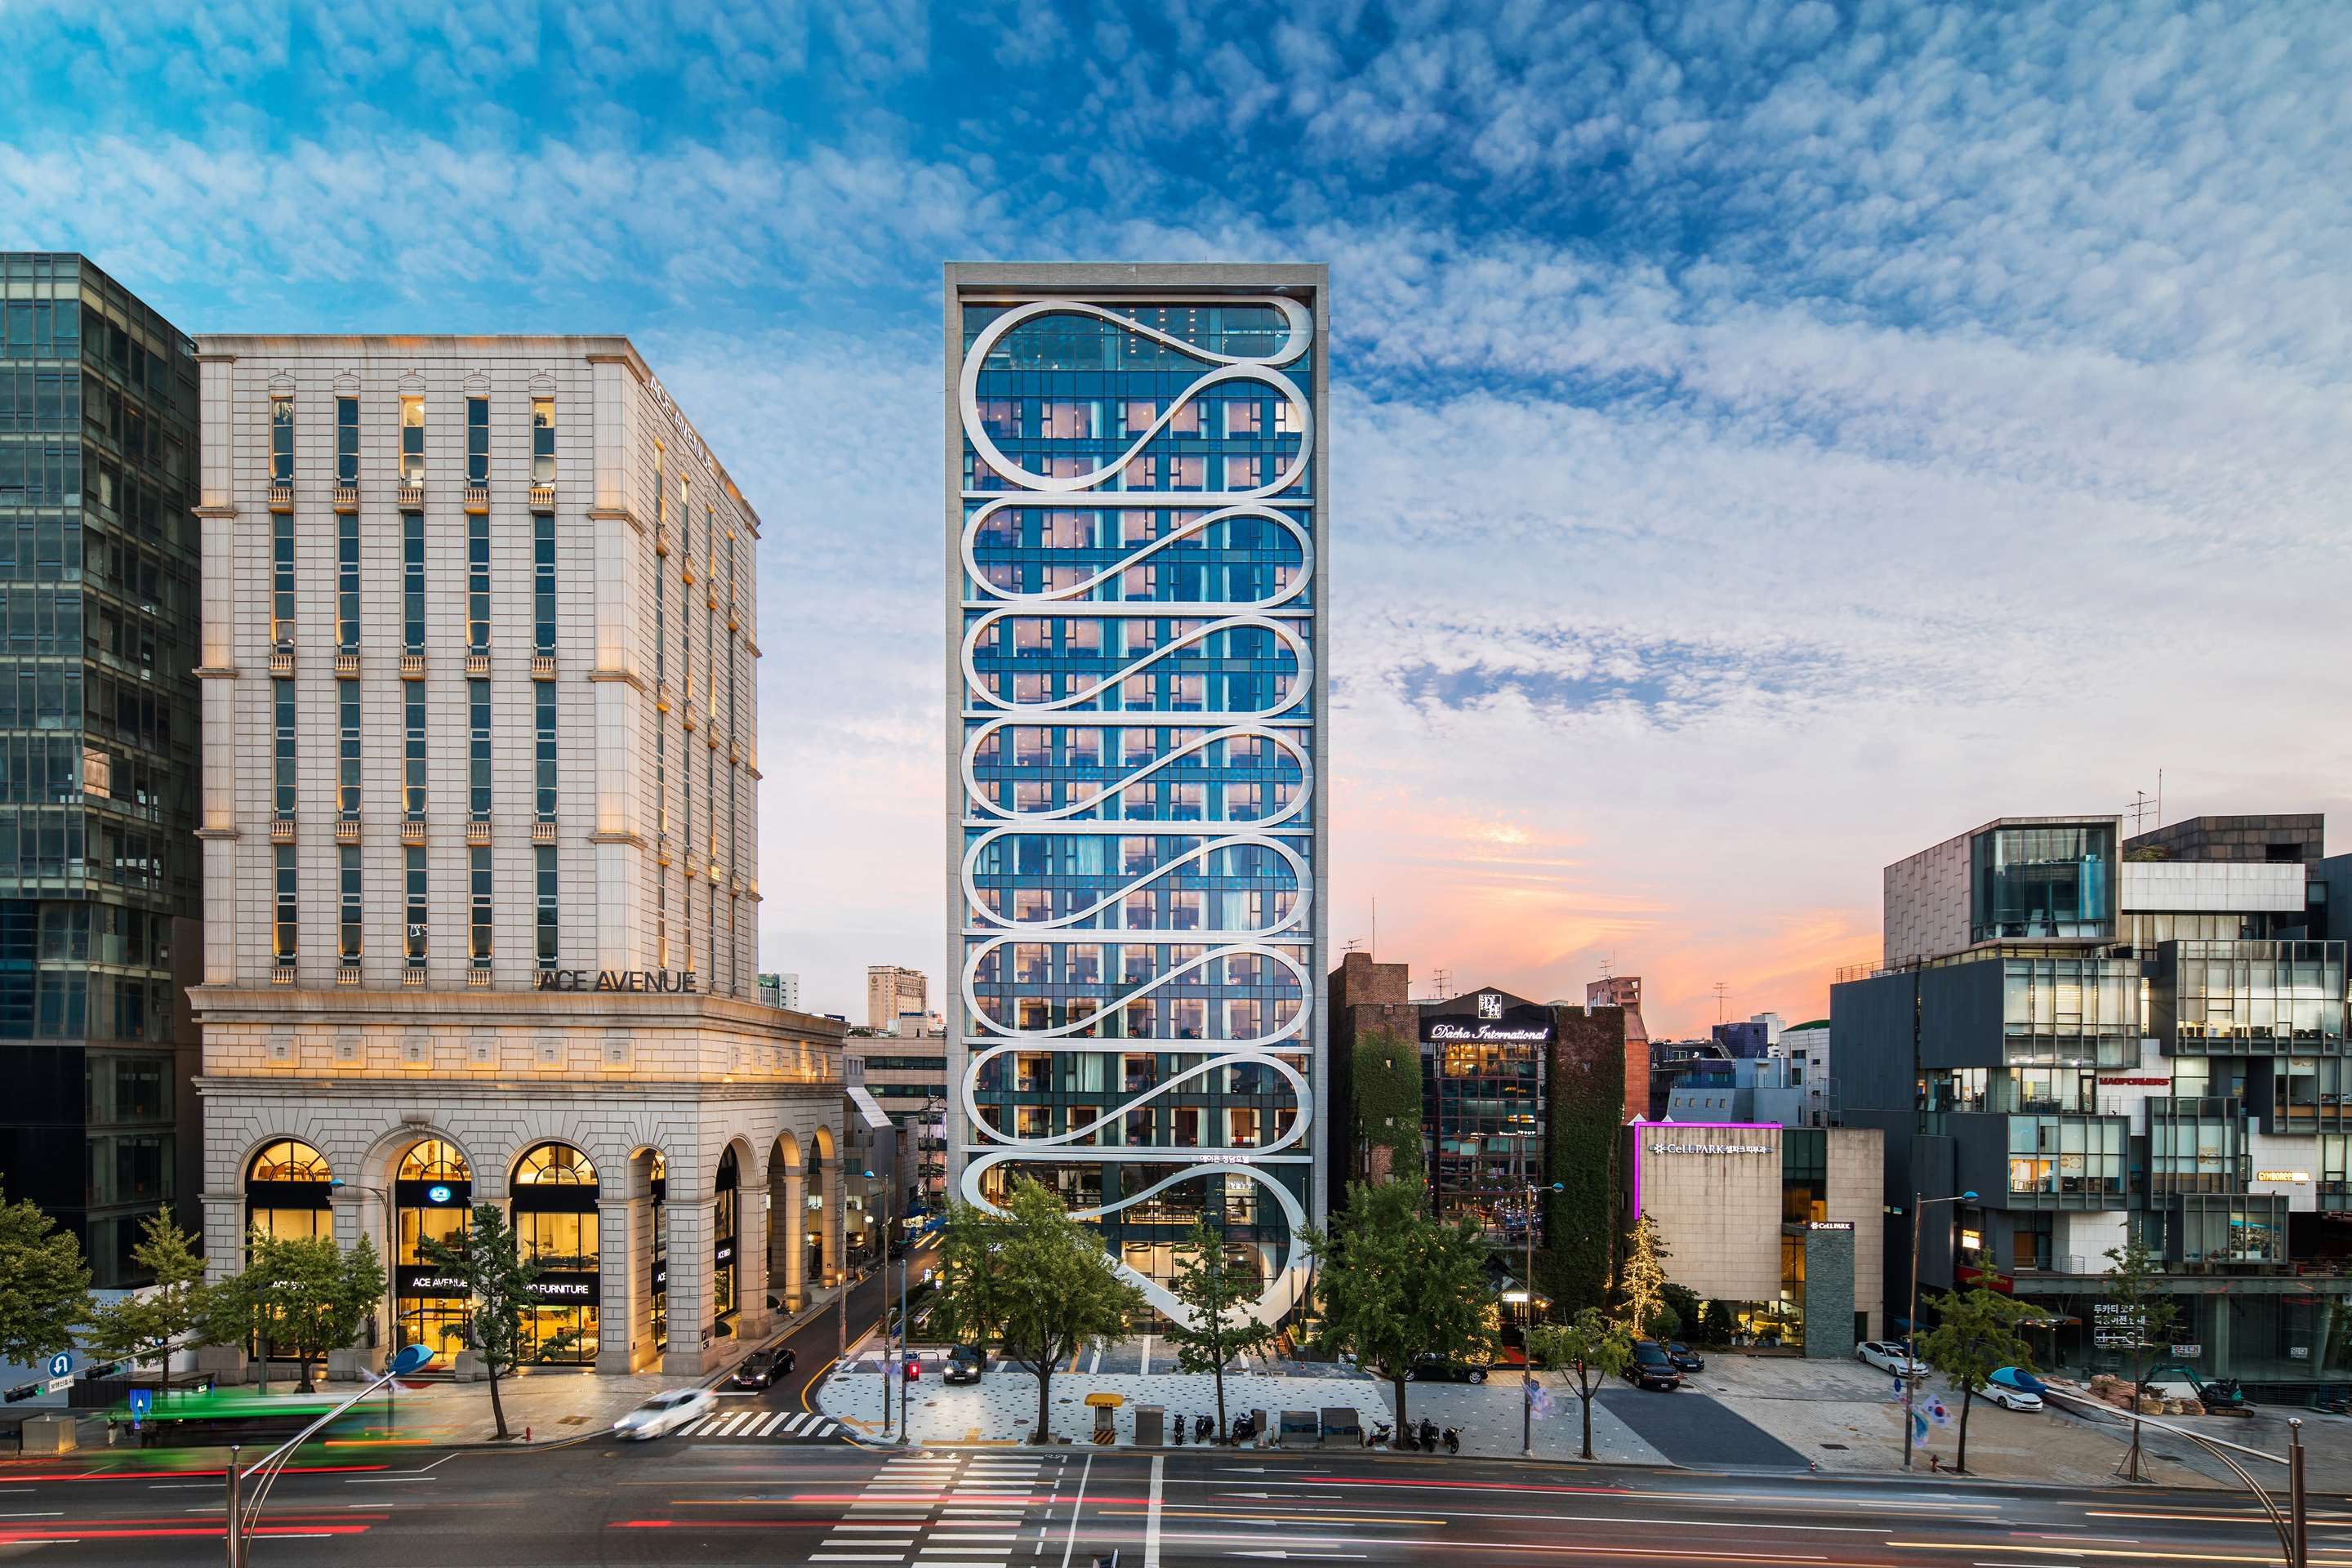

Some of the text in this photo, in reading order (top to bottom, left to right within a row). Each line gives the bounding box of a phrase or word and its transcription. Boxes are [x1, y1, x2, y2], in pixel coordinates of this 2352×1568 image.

[649, 376, 713, 474] ACE AVENUE
[538, 970, 697, 992] ACE AVENUE
[1472, 1024, 1548, 1040] International
[412, 1277, 468, 1288] ACE AVENUE
[657, 1272, 666, 1282] ACE
[539, 1285, 589, 1294] FURNITURE
[2094, 1304, 2146, 1314] 두카티 코리
